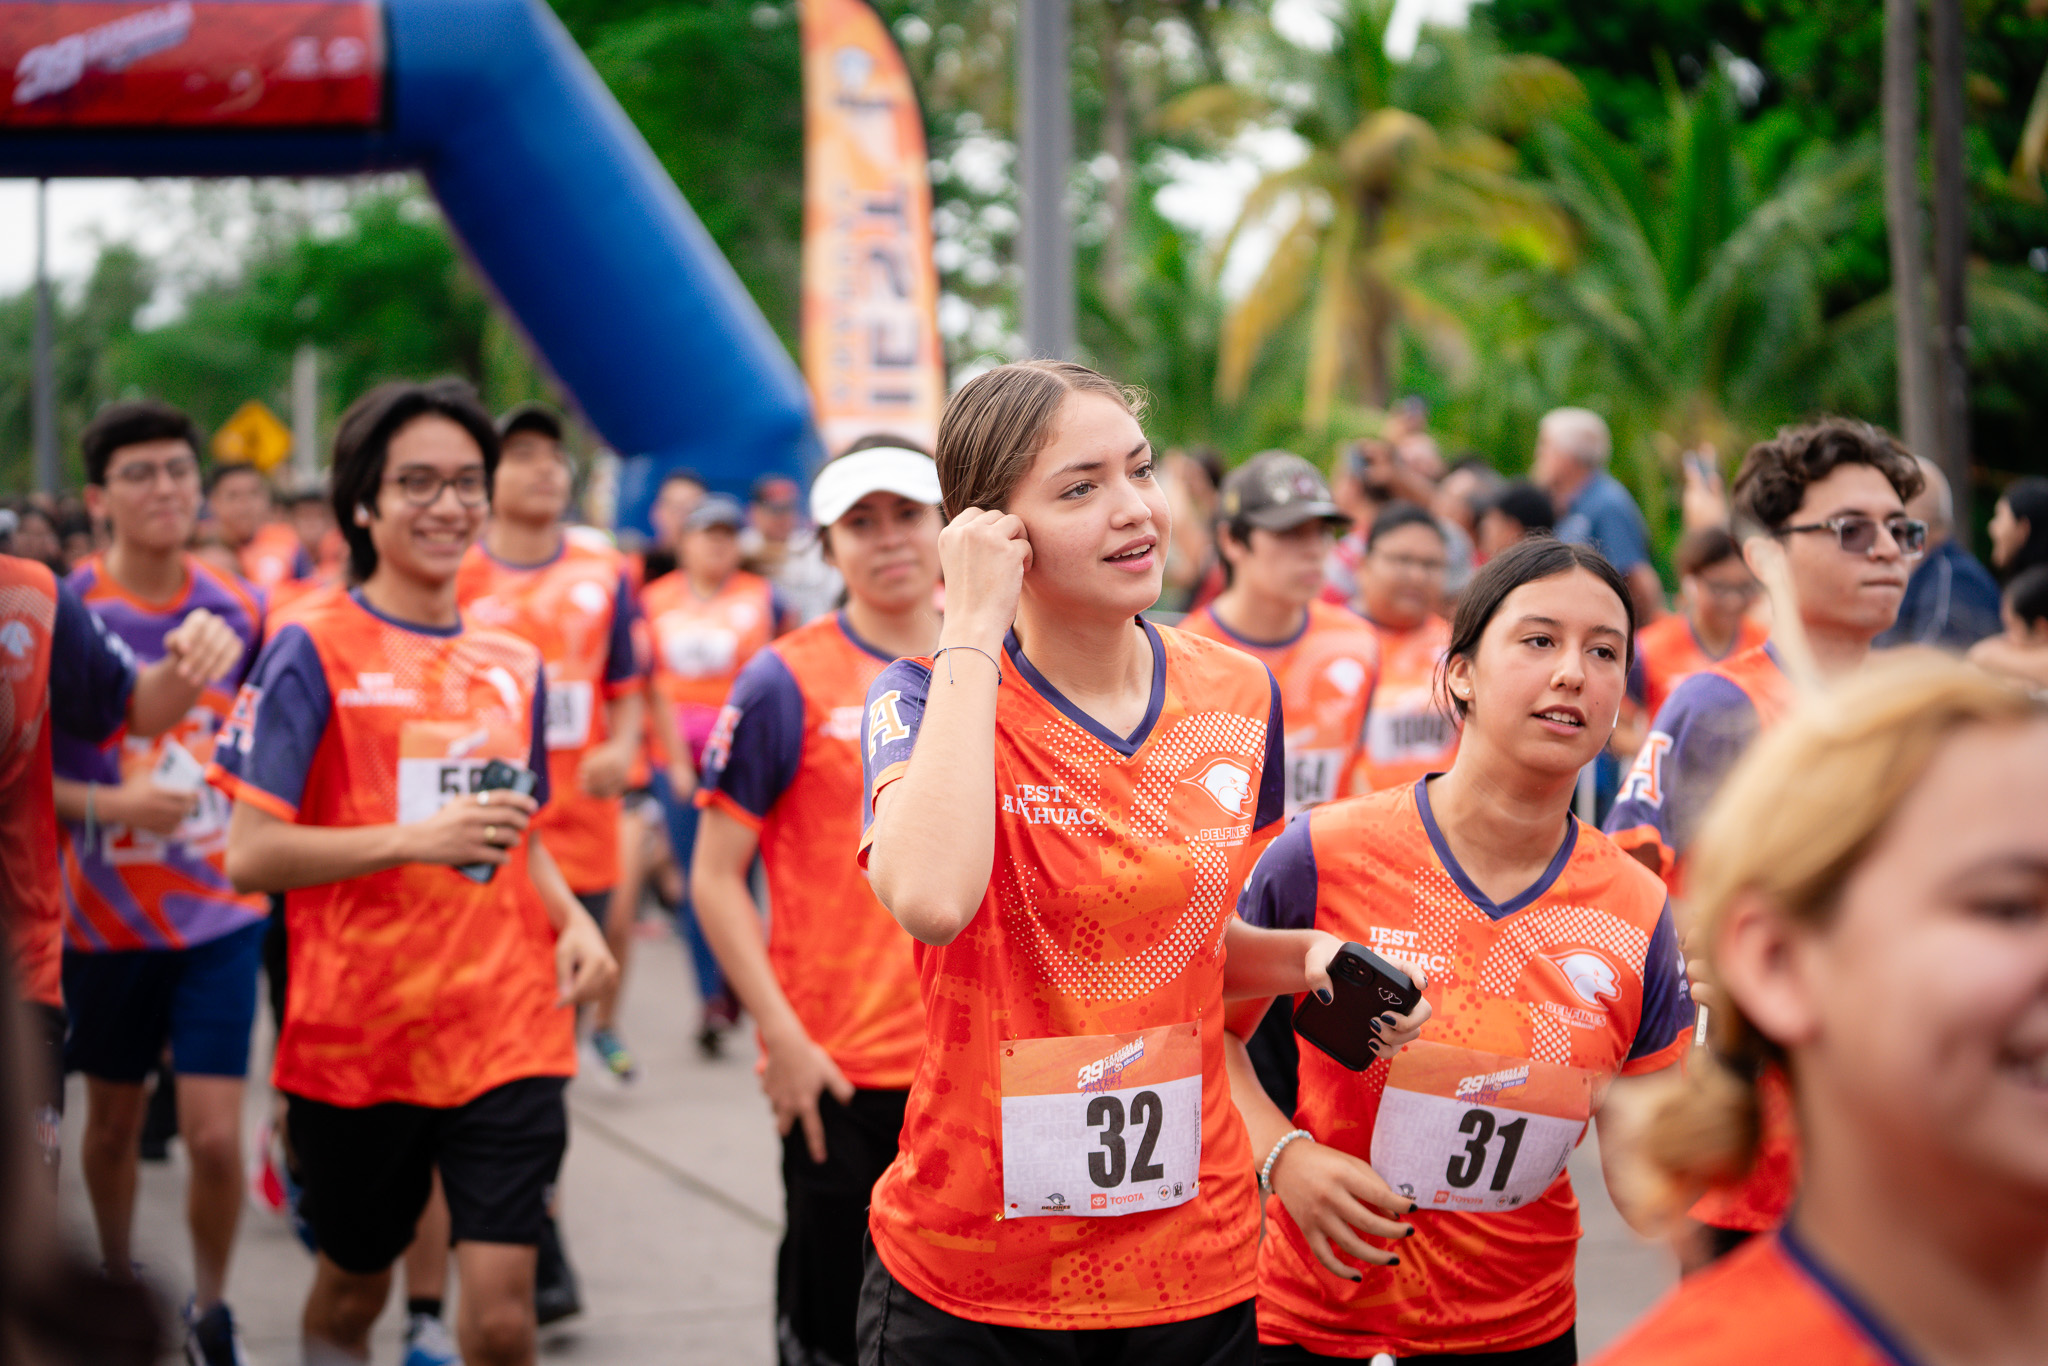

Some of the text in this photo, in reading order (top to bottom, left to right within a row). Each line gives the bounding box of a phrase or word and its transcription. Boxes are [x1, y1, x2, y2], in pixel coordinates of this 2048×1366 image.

[867, 690, 911, 765] A
[1200, 823, 1251, 842] DELFINES
[1369, 926, 1419, 948] IEST
[1077, 1059, 1104, 1090] 39
[1455, 1074, 1486, 1097] 39
[1086, 1090, 1164, 1189] 32
[1446, 1109, 1529, 1192] 31
[1109, 1193, 1144, 1205] TOYOTA
[1450, 1194, 1484, 1205] TOYOTA
